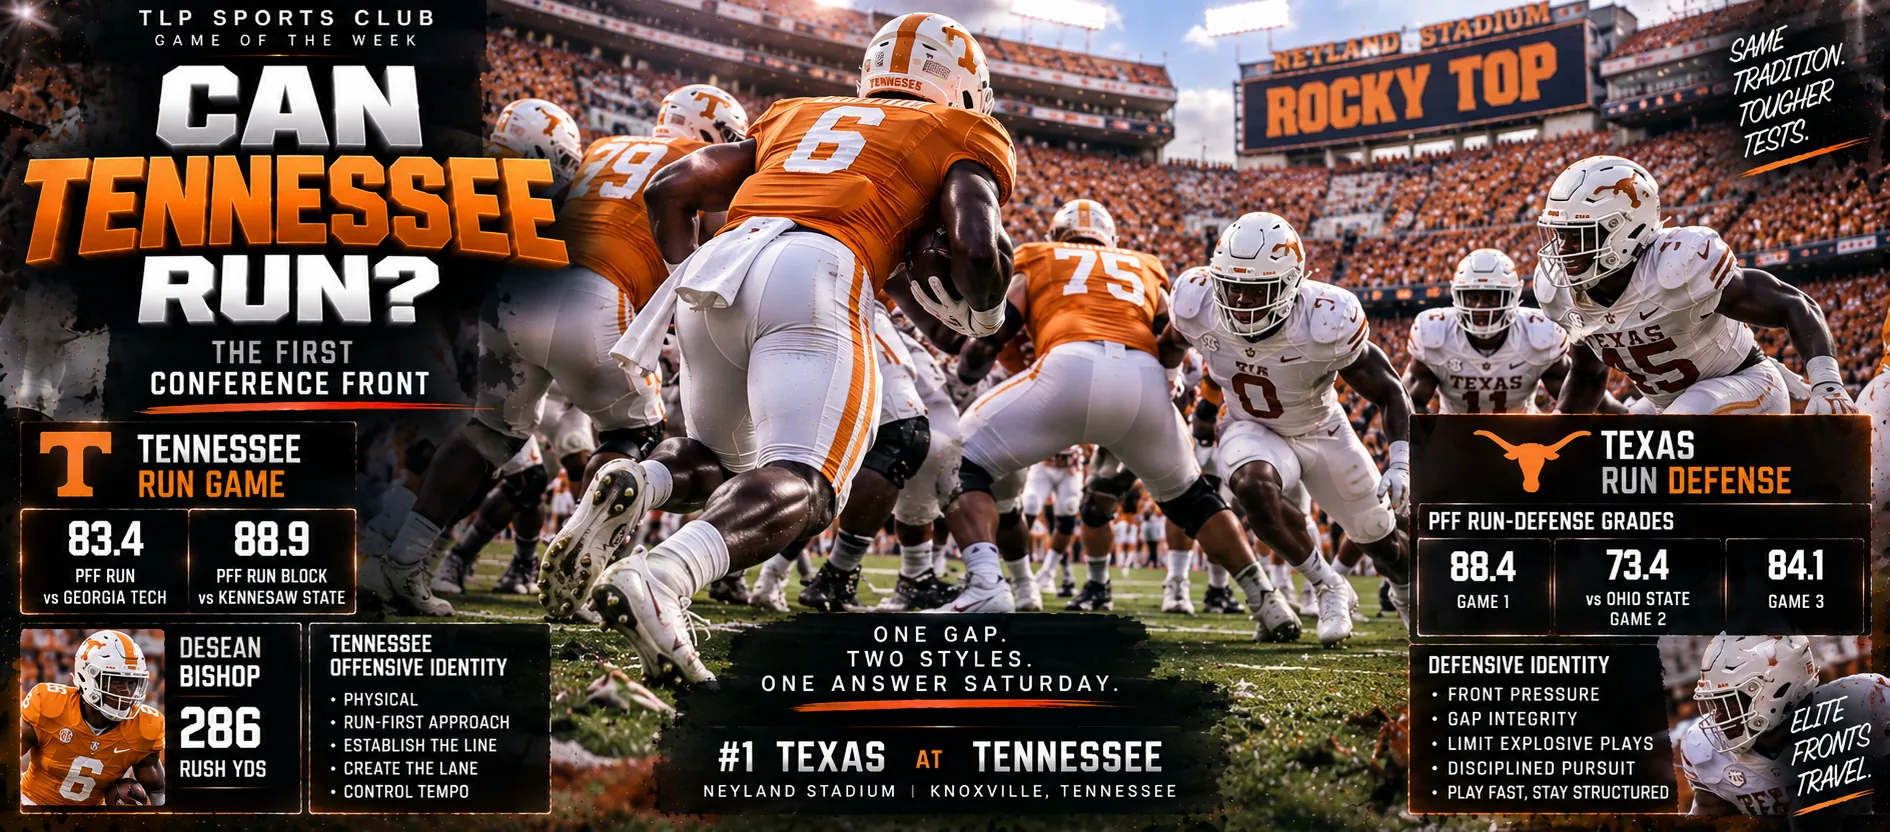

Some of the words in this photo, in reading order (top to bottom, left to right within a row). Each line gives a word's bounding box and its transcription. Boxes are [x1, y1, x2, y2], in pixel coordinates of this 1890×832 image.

[1273, 32, 1400, 72] NEYLAND
[1420, 1, 1551, 48] STADIUM
[1266, 63, 1431, 139] ROCKY
[1449, 42, 1558, 112] TOP
[783, 105, 887, 174] 6
[566, 142, 669, 200] 79
[1053, 247, 1145, 307] 75
[1231, 372, 1285, 419] 0
[1450, 375, 1523, 390] TEXAS
[1462, 390, 1508, 413] 11
[58, 755, 105, 802] 6
